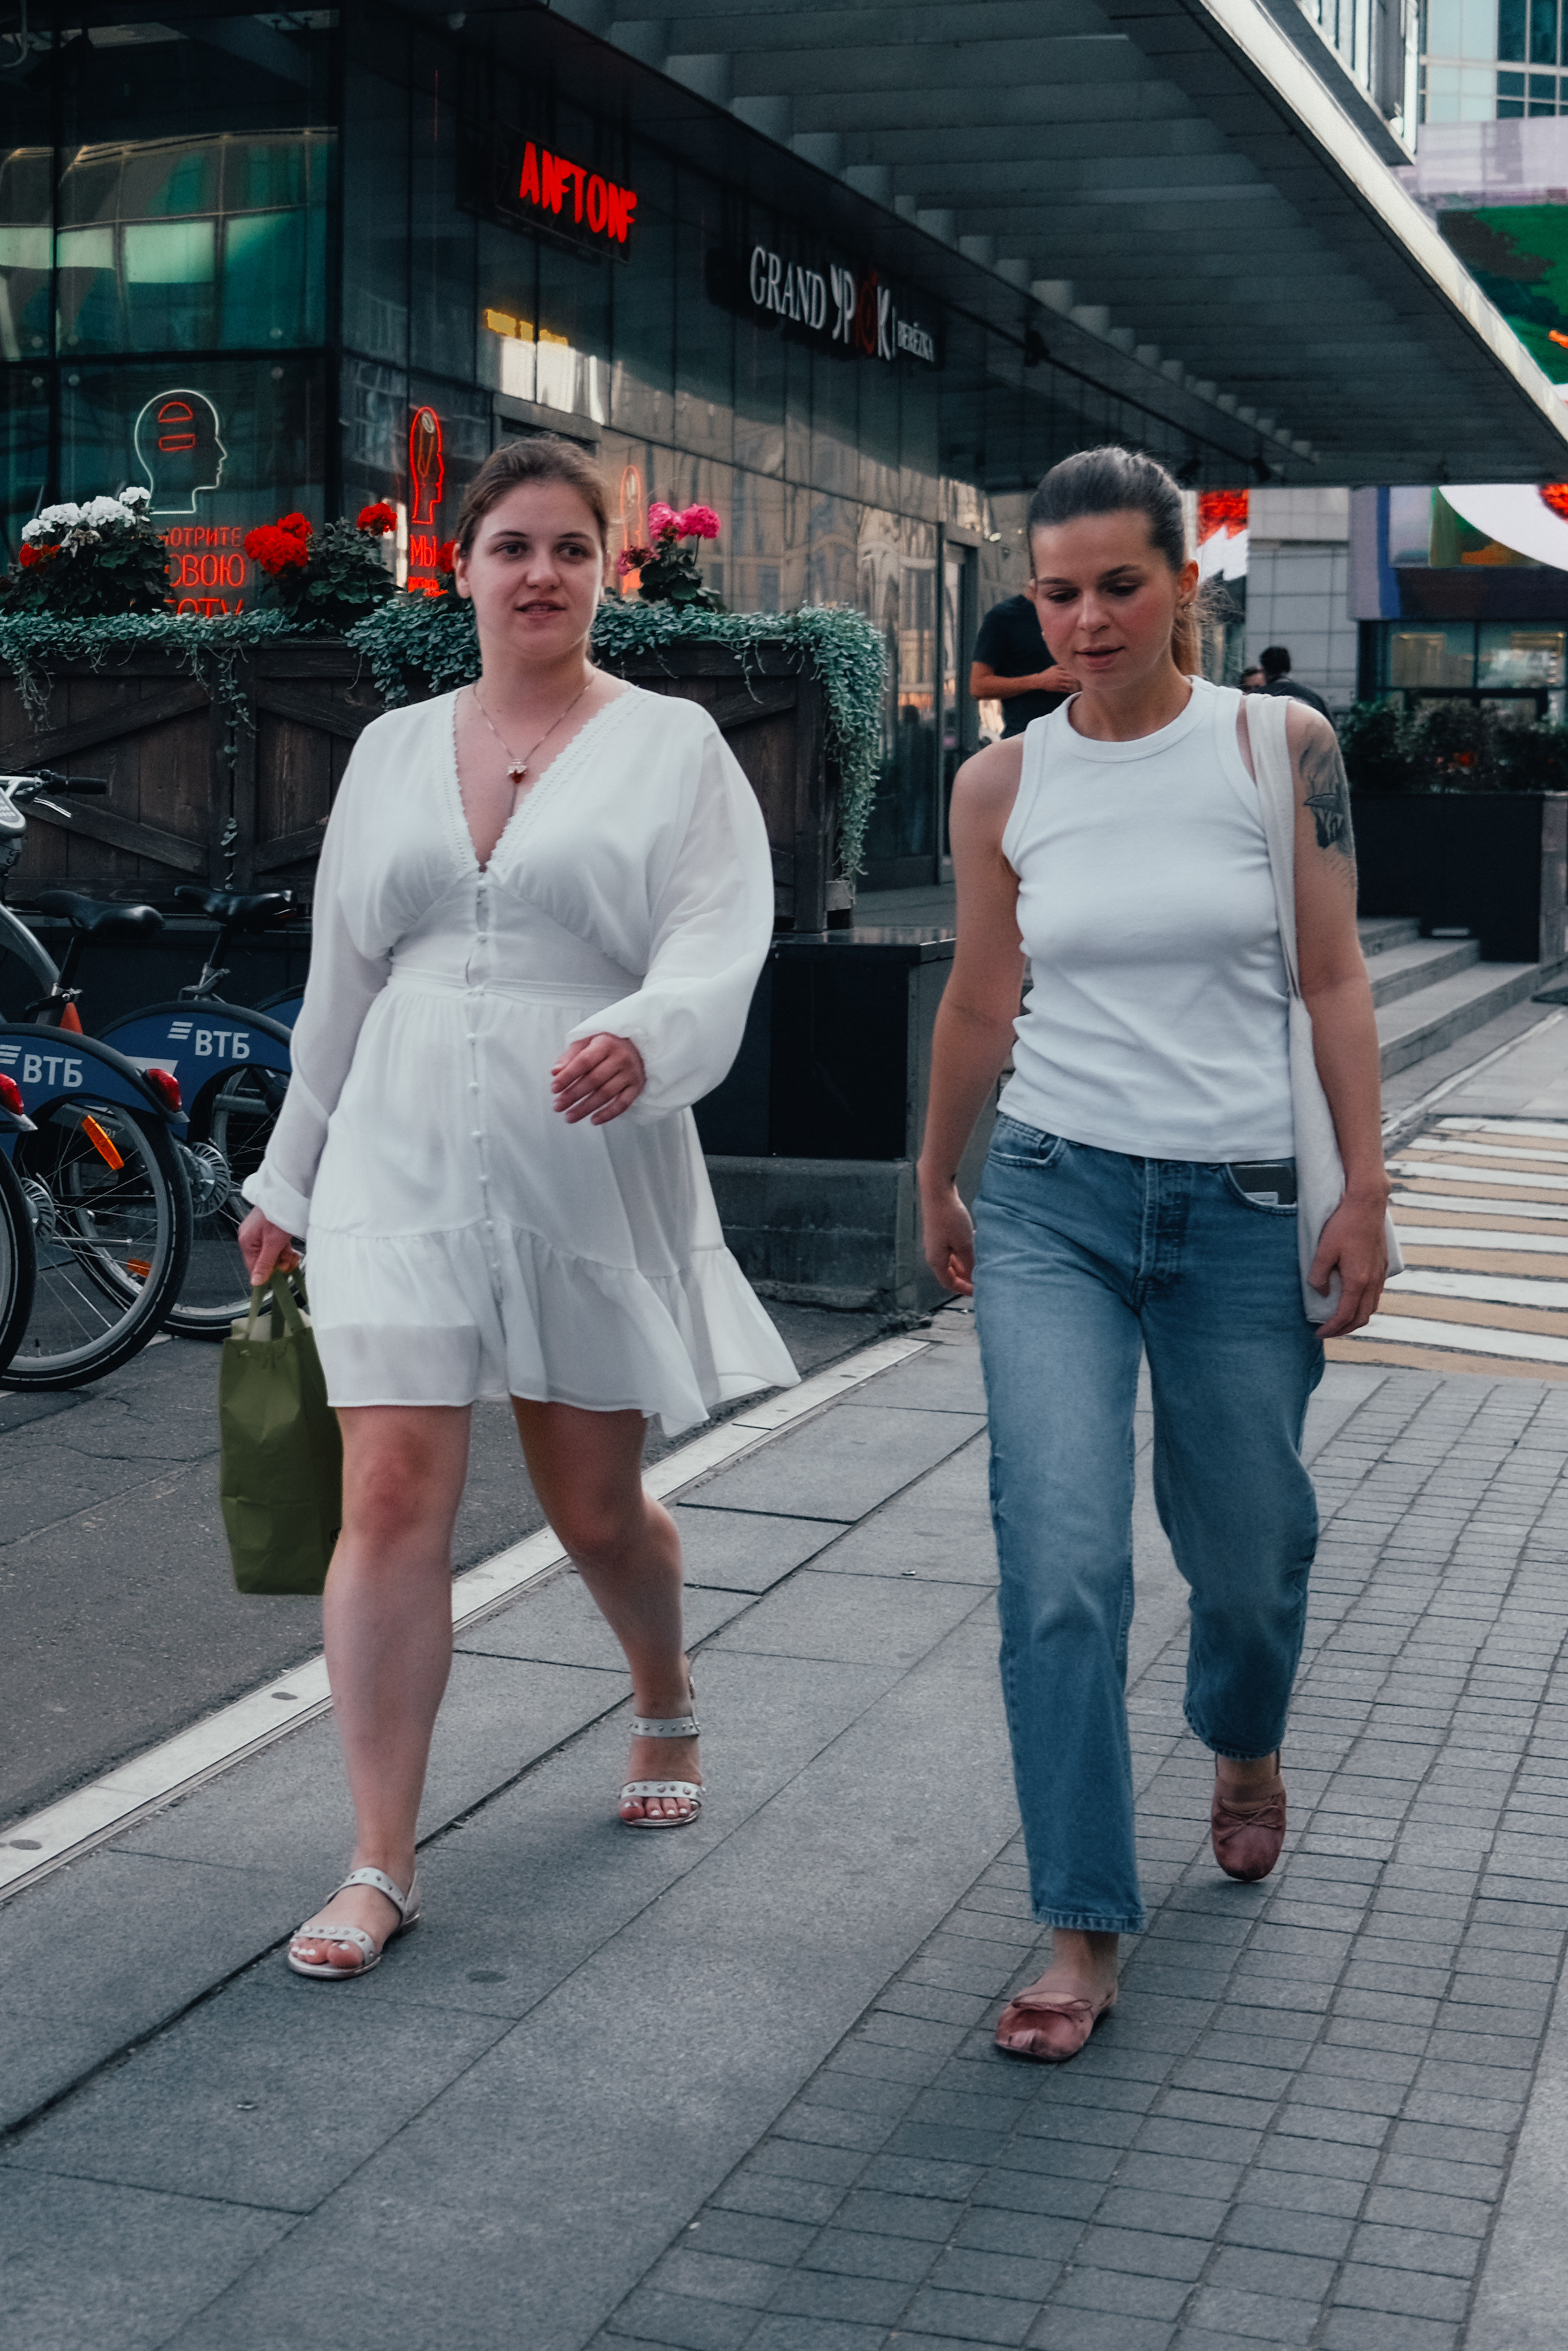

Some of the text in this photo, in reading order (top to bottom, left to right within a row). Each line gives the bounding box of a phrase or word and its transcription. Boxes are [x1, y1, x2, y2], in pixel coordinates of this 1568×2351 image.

[750, 245, 827, 330] GRAND
[410, 534, 437, 567] МЫ
[195, 1029, 250, 1059] ВТБ
[23, 1053, 83, 1087] ВТБ
